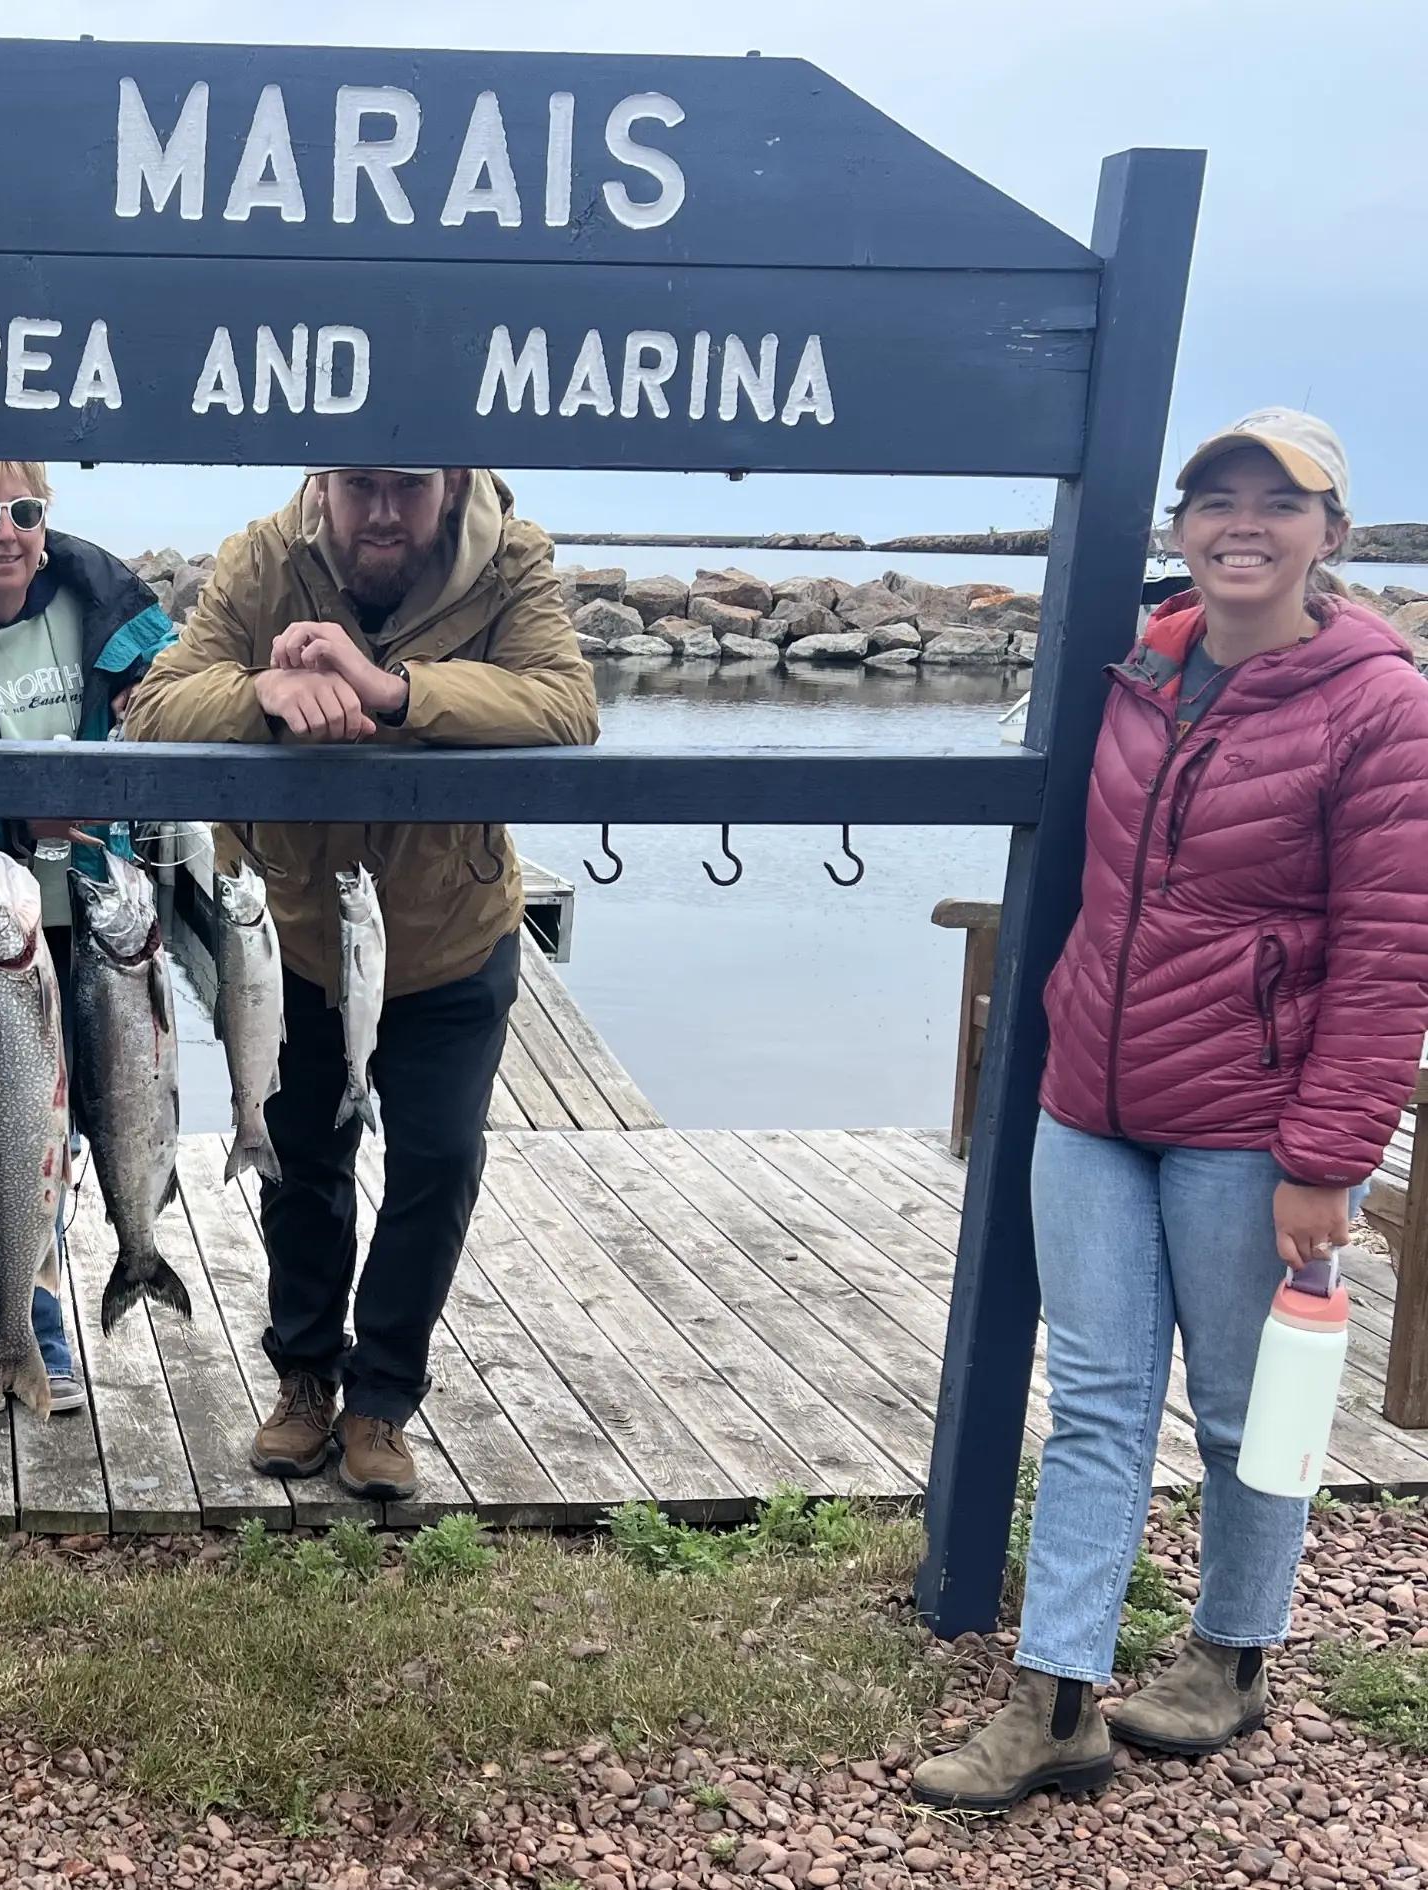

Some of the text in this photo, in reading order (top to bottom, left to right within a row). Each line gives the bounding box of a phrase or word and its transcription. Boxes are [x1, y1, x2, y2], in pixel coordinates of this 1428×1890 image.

[115, 78, 686, 231] MARAIS
[192, 323, 370, 415] AND
[476, 325, 835, 427] MARINA
